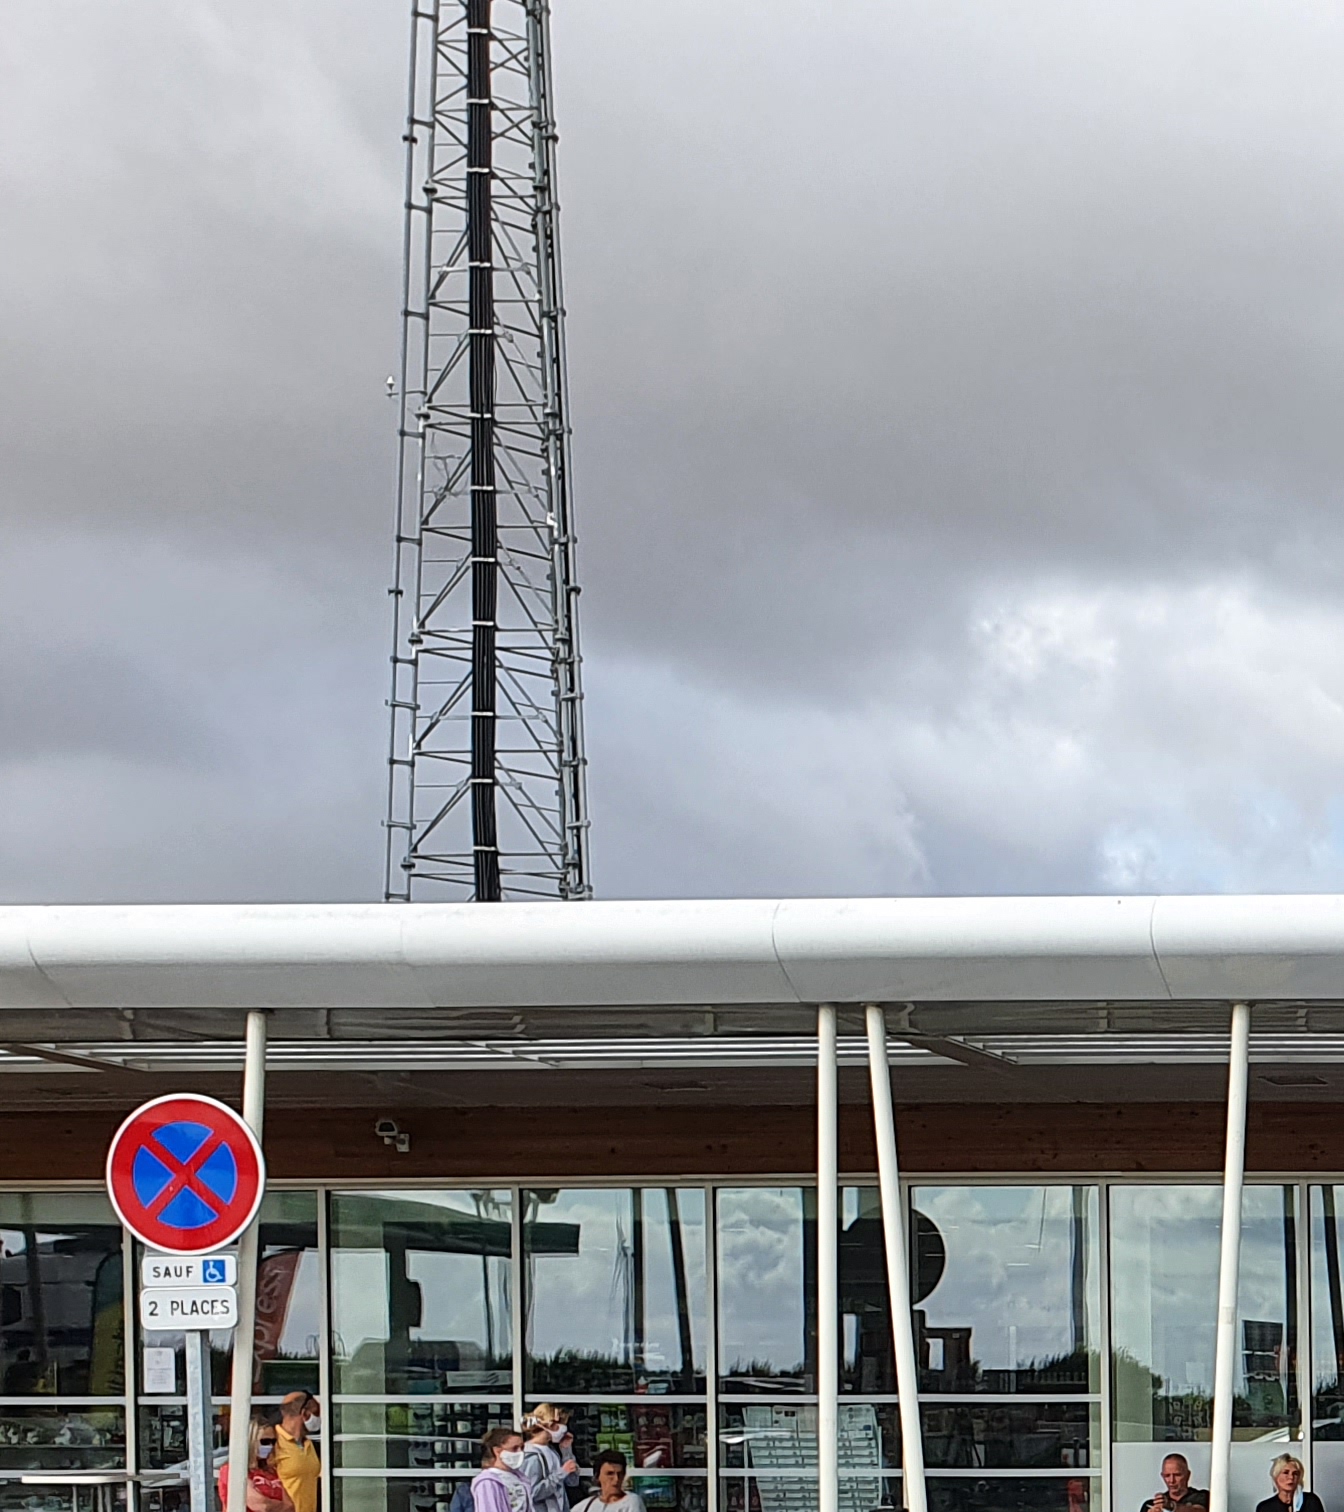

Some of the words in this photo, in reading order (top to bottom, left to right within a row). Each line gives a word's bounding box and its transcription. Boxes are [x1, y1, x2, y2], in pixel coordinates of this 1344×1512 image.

[152, 1265, 194, 1279] SAUF
[148, 1301, 159, 1316] 2
[170, 1299, 230, 1316] PLACES
